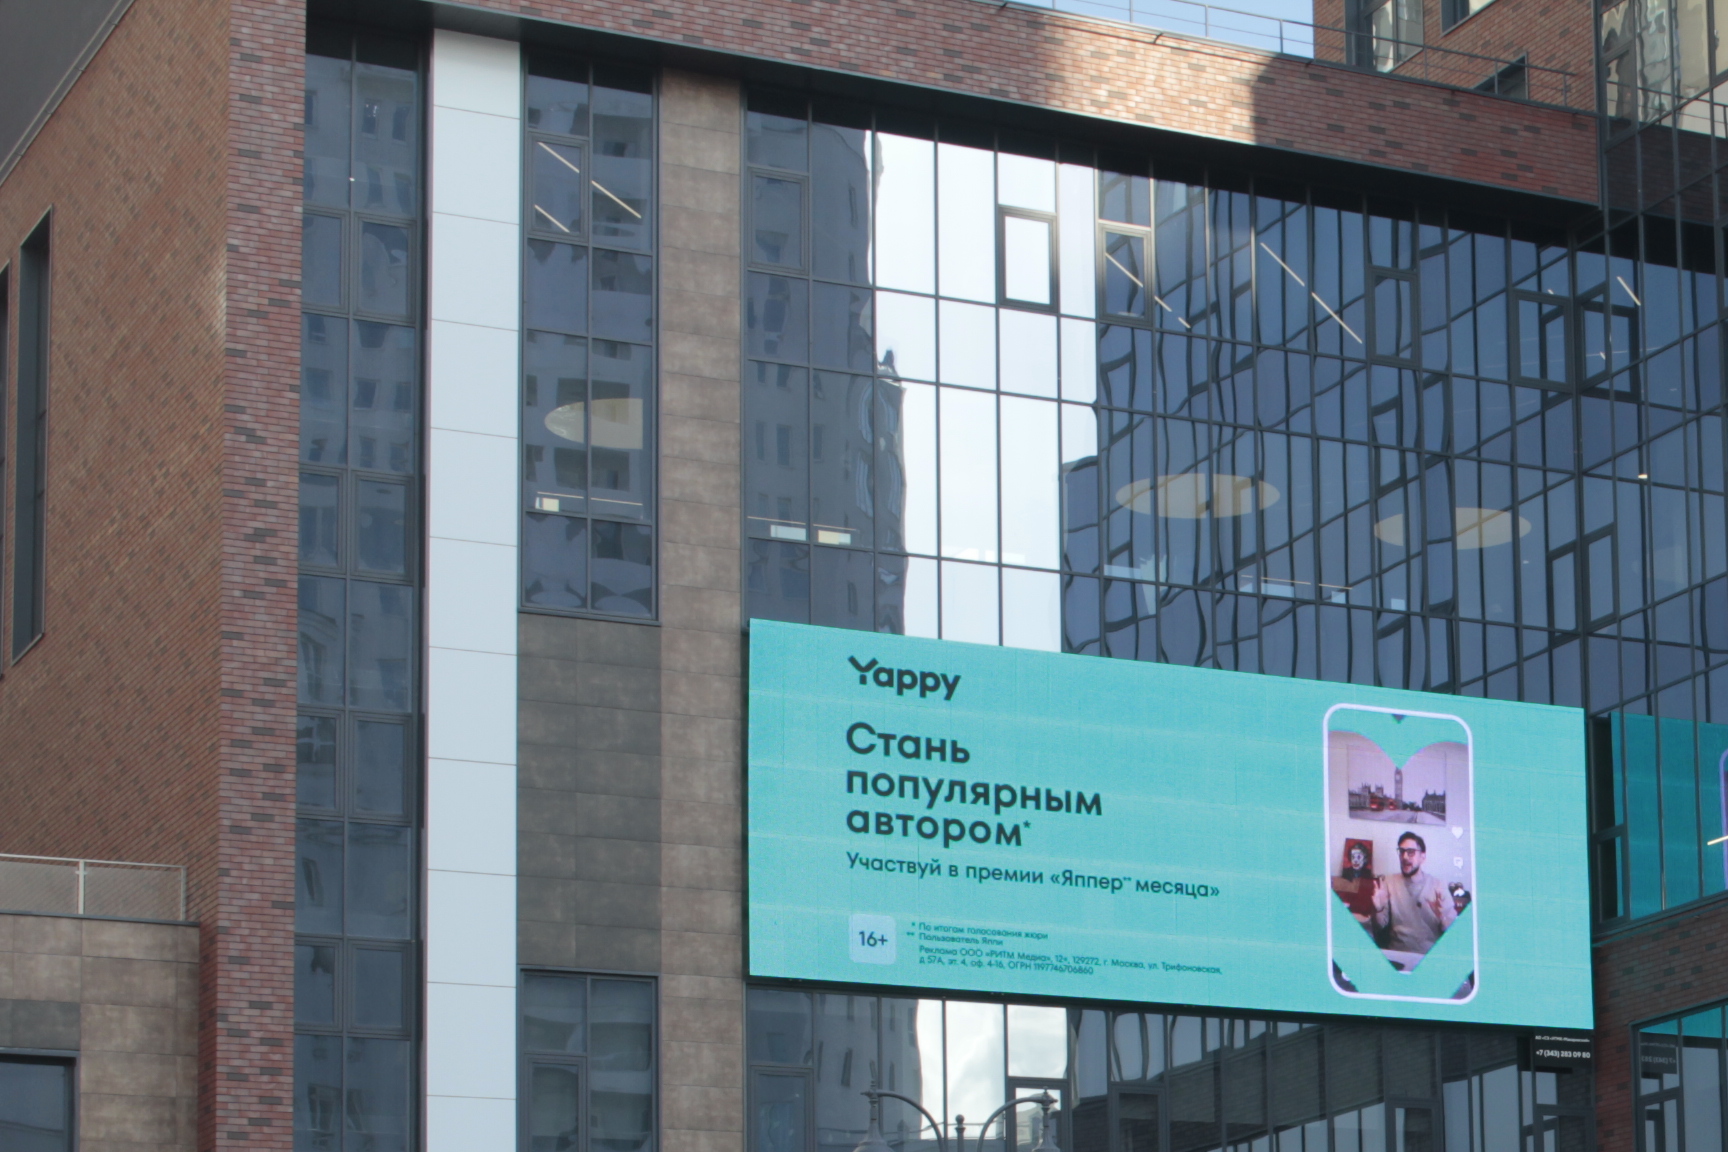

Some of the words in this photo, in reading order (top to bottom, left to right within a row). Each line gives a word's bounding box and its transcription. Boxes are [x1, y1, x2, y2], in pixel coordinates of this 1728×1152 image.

[847, 655, 961, 700] Yappy
[846, 721, 970, 763] Стань
[846, 770, 1102, 816] популярным
[846, 851, 941, 879] Участвуй
[948, 863, 959, 877] в
[966, 865, 1044, 884] премии
[1135, 880, 1220, 899] месяца»
[858, 931, 888, 947] 16+
[959, 948, 984, 958] ООО
